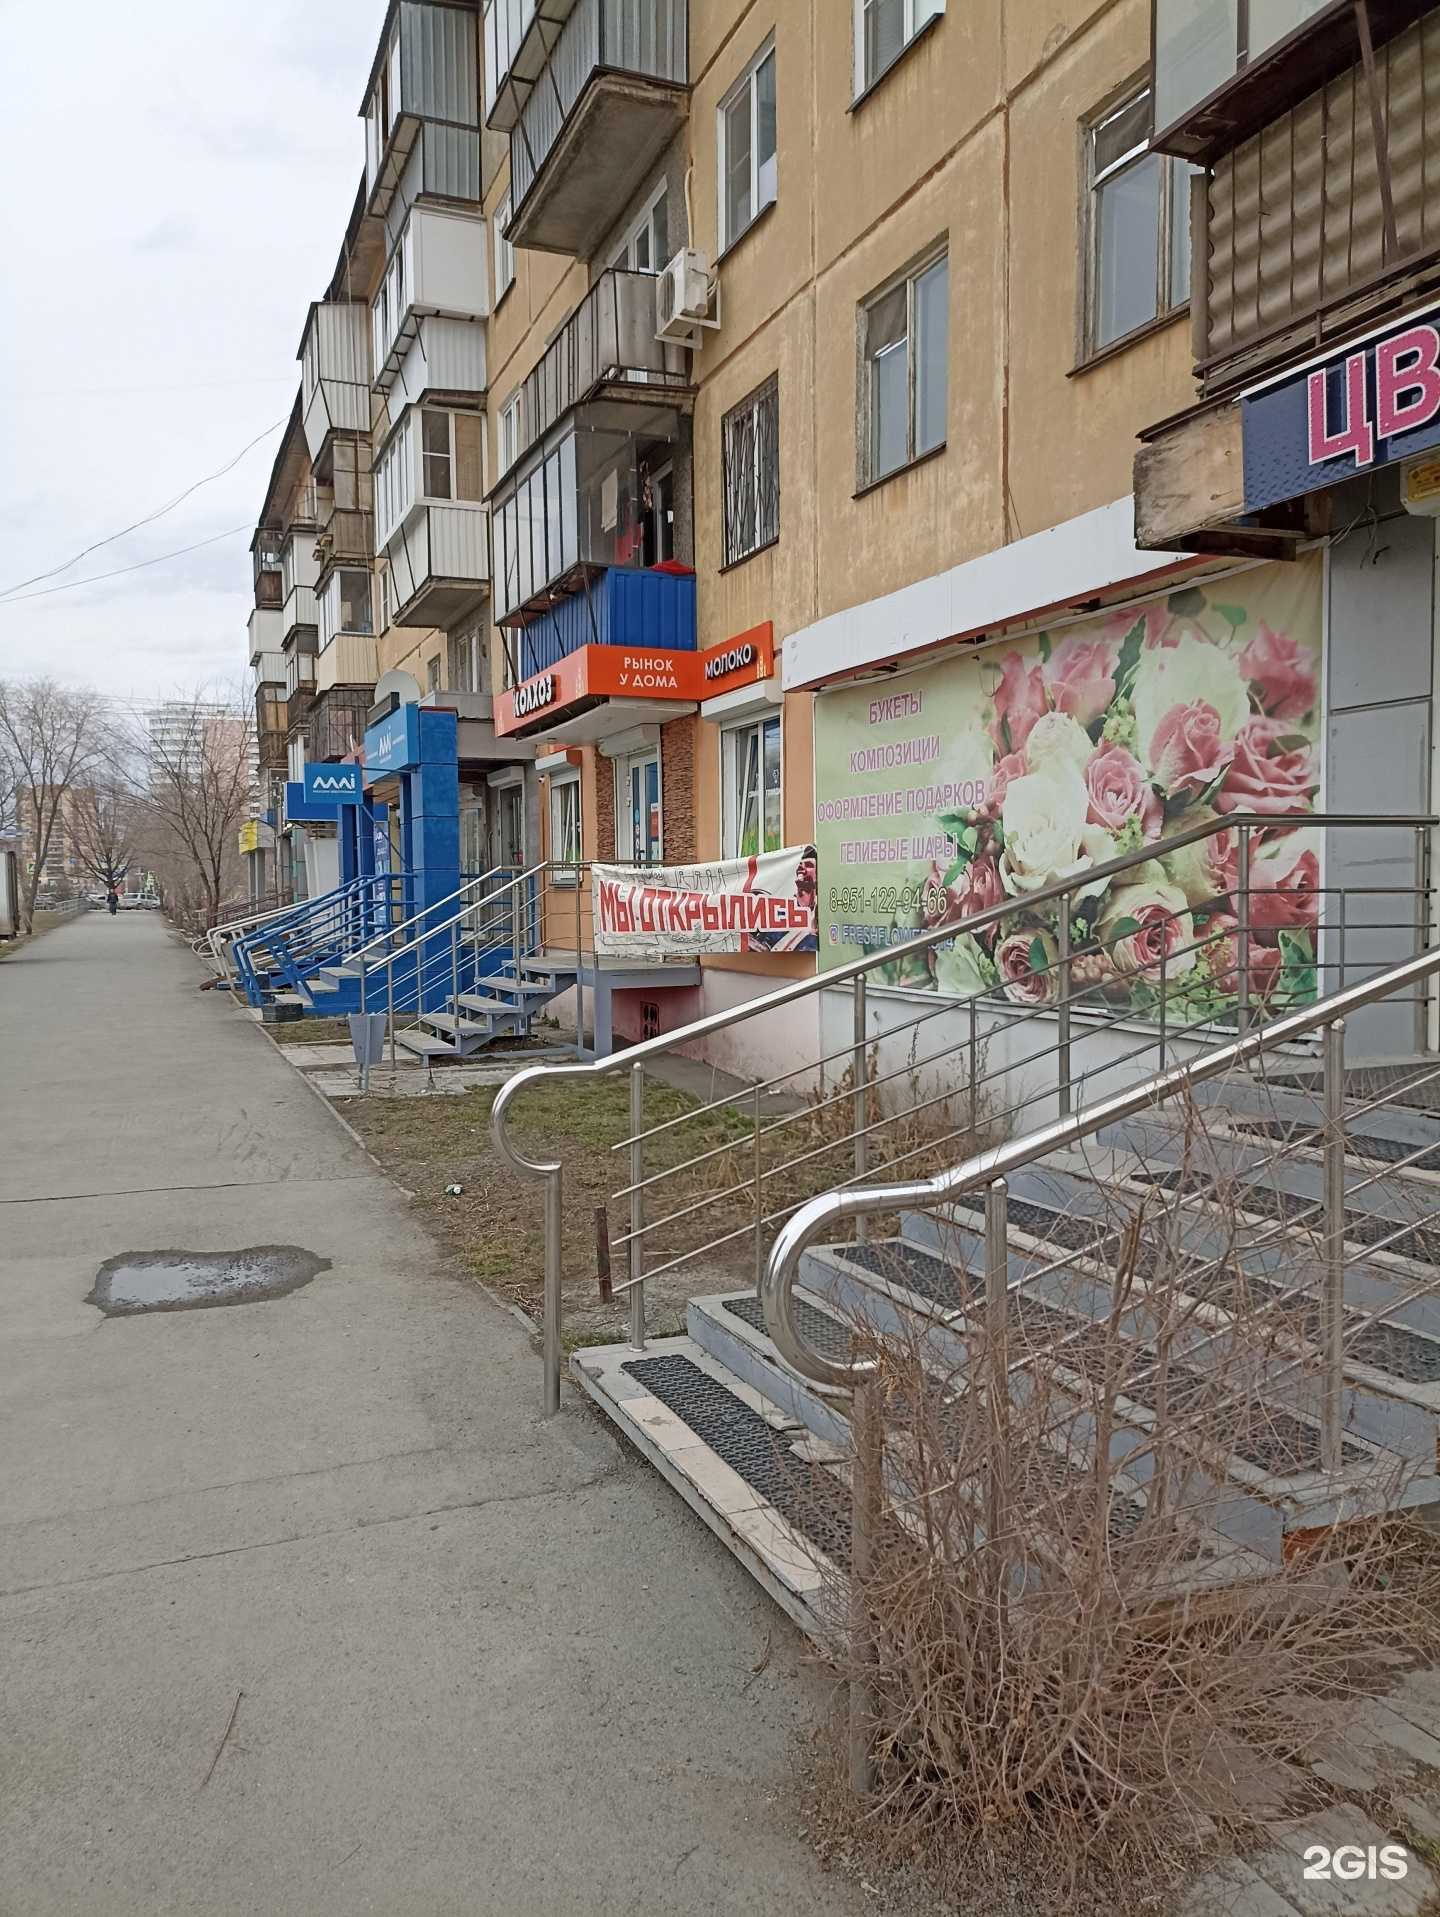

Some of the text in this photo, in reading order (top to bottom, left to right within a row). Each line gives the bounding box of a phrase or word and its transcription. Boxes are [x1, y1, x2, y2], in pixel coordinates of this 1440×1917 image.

[624, 656, 673, 671] РЫНОК
[704, 643, 752, 681] МОЛОКО
[512, 673, 552, 718] КОЛХОЗ
[619, 674, 678, 688] У ДОМА
[869, 690, 923, 724] БУКЕТЫ
[850, 735, 940, 773] КОМПОЗИЦИИ
[817, 779, 985, 822] ОФОРМЛЕНИЕ ПОДАРКОВ
[840, 832, 958, 865] ГЕЛИЕВЫЕ ШАРЫ
[599, 880, 808, 933] МЫ ОТКРЫЛИСЬ
[829, 886, 948, 915] 8-951-122-94-66
